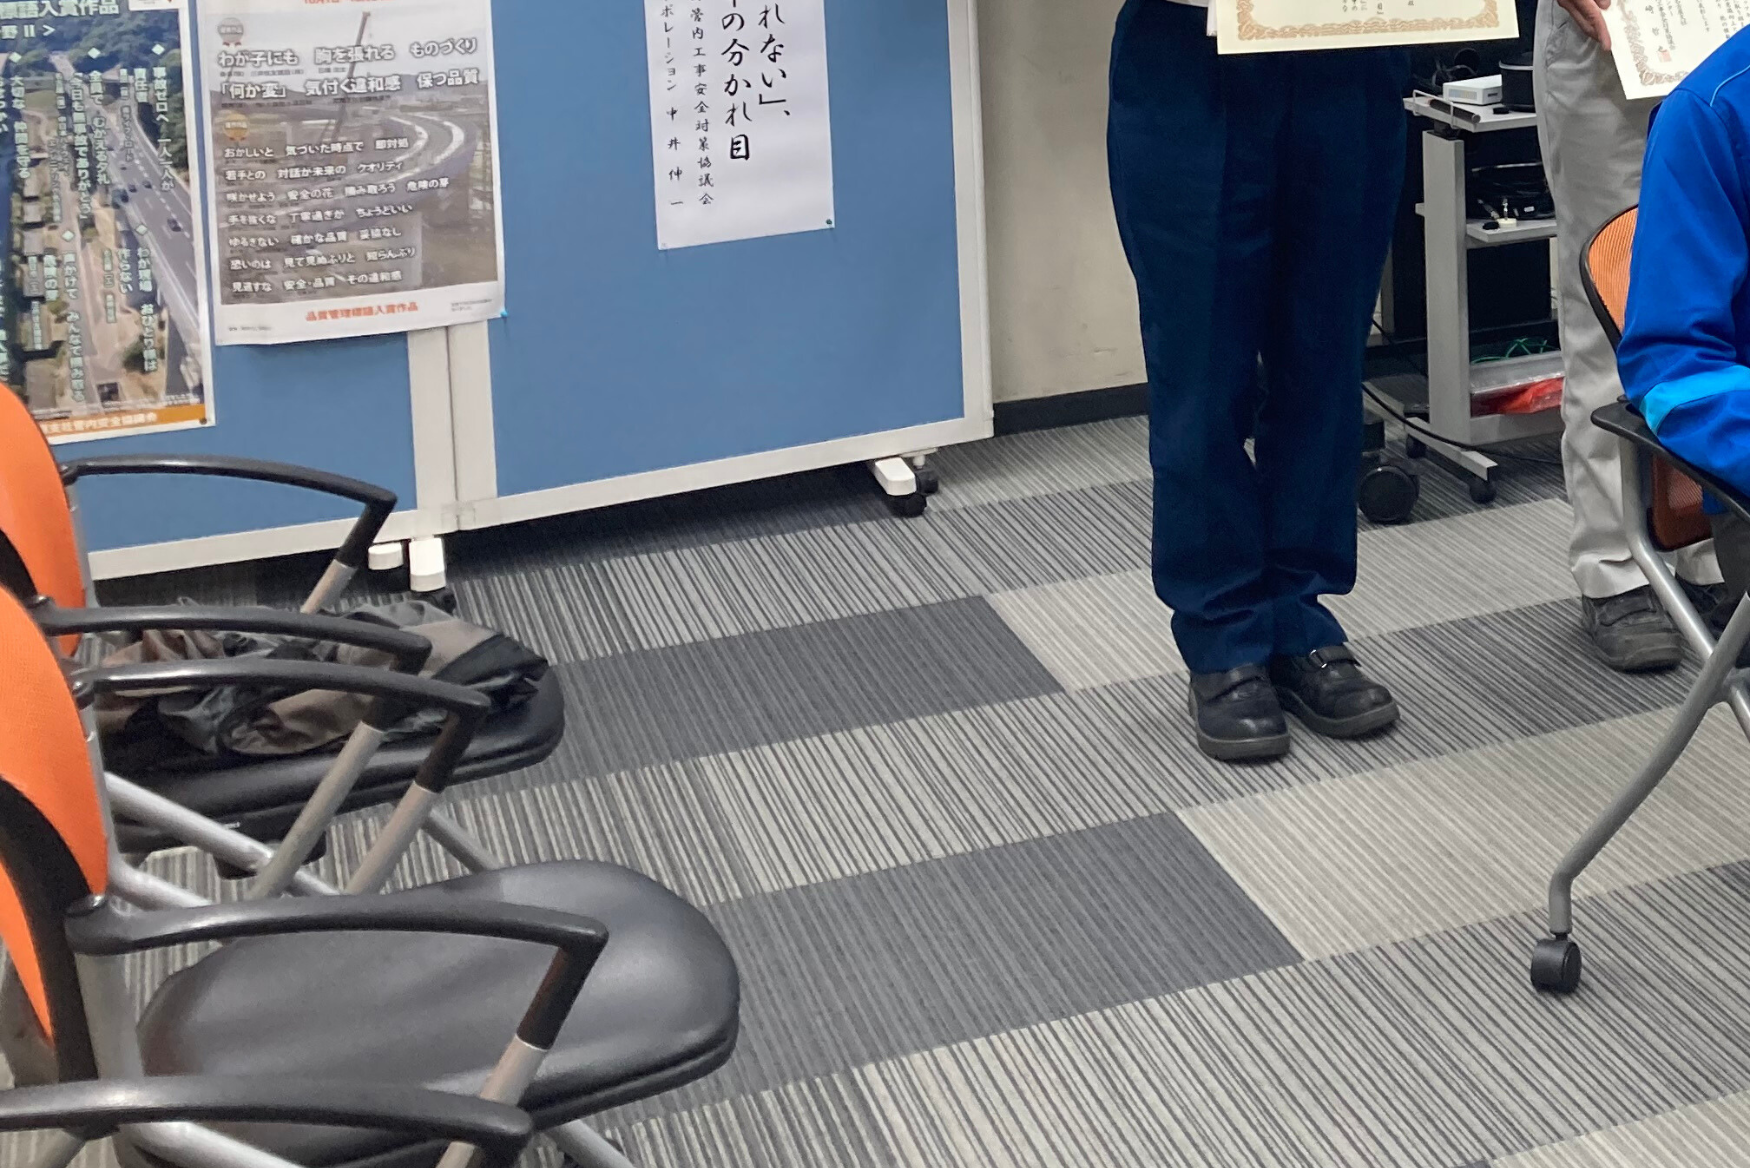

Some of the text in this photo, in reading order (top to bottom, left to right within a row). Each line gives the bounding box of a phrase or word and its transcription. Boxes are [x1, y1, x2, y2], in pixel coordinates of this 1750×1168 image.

[219, 50, 298, 67] わが子にも
[409, 38, 478, 58] ものづくり
